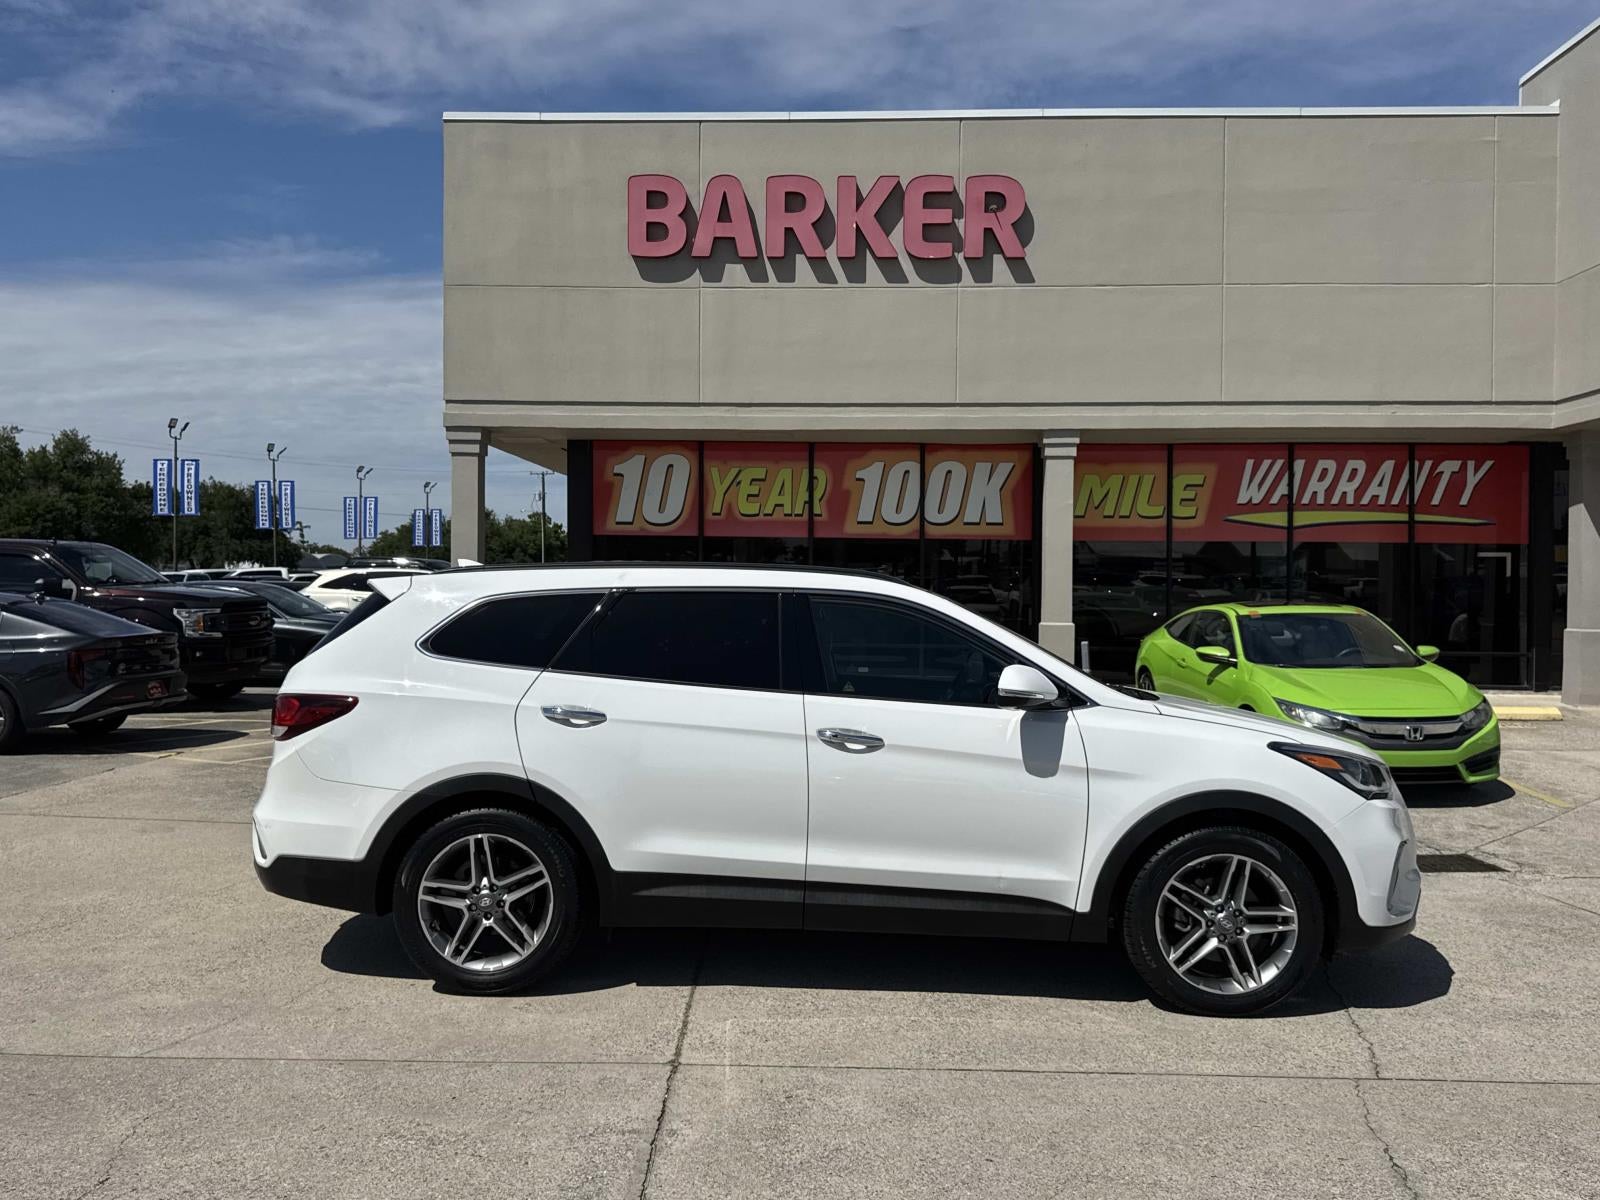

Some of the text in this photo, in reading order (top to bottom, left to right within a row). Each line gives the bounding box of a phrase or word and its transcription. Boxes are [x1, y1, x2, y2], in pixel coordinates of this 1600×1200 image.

[627, 174, 1027, 259] BARKER
[186, 467, 194, 513] PREOWNED
[612, 453, 1495, 527] 10 YEAR 100K MILE WARRANTY
